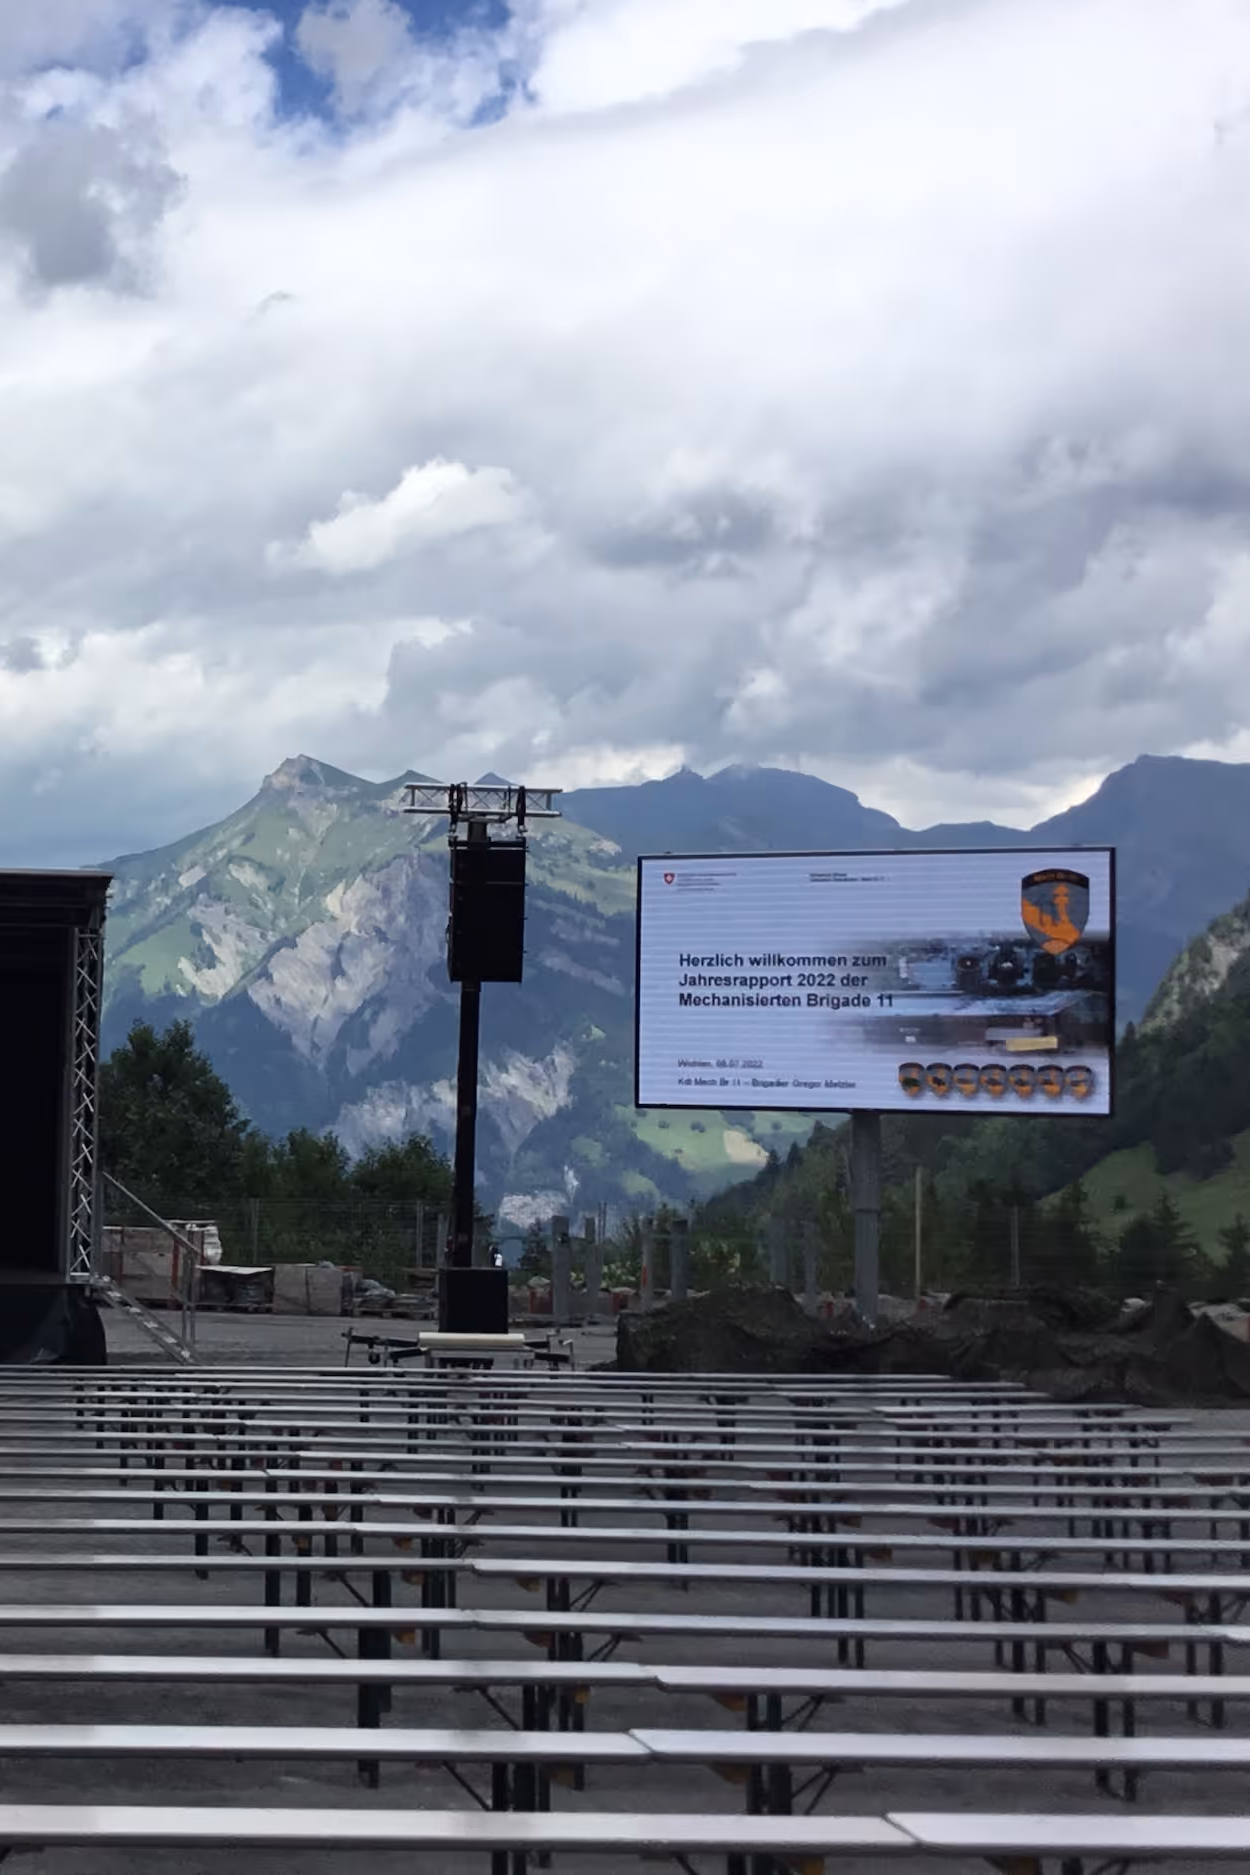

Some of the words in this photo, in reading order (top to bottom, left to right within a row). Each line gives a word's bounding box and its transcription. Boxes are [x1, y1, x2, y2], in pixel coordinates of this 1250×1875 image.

[679, 953, 744, 967] Herzlich
[748, 953, 847, 967] willkommen
[851, 955, 887, 967] zum
[678, 973, 792, 990] Jahresrapport
[797, 973, 835, 987] 2022
[840, 973, 868, 987] der
[679, 993, 801, 1007] Mechanisierten
[806, 993, 871, 1010] Brigade
[877, 994, 894, 1007] 11
